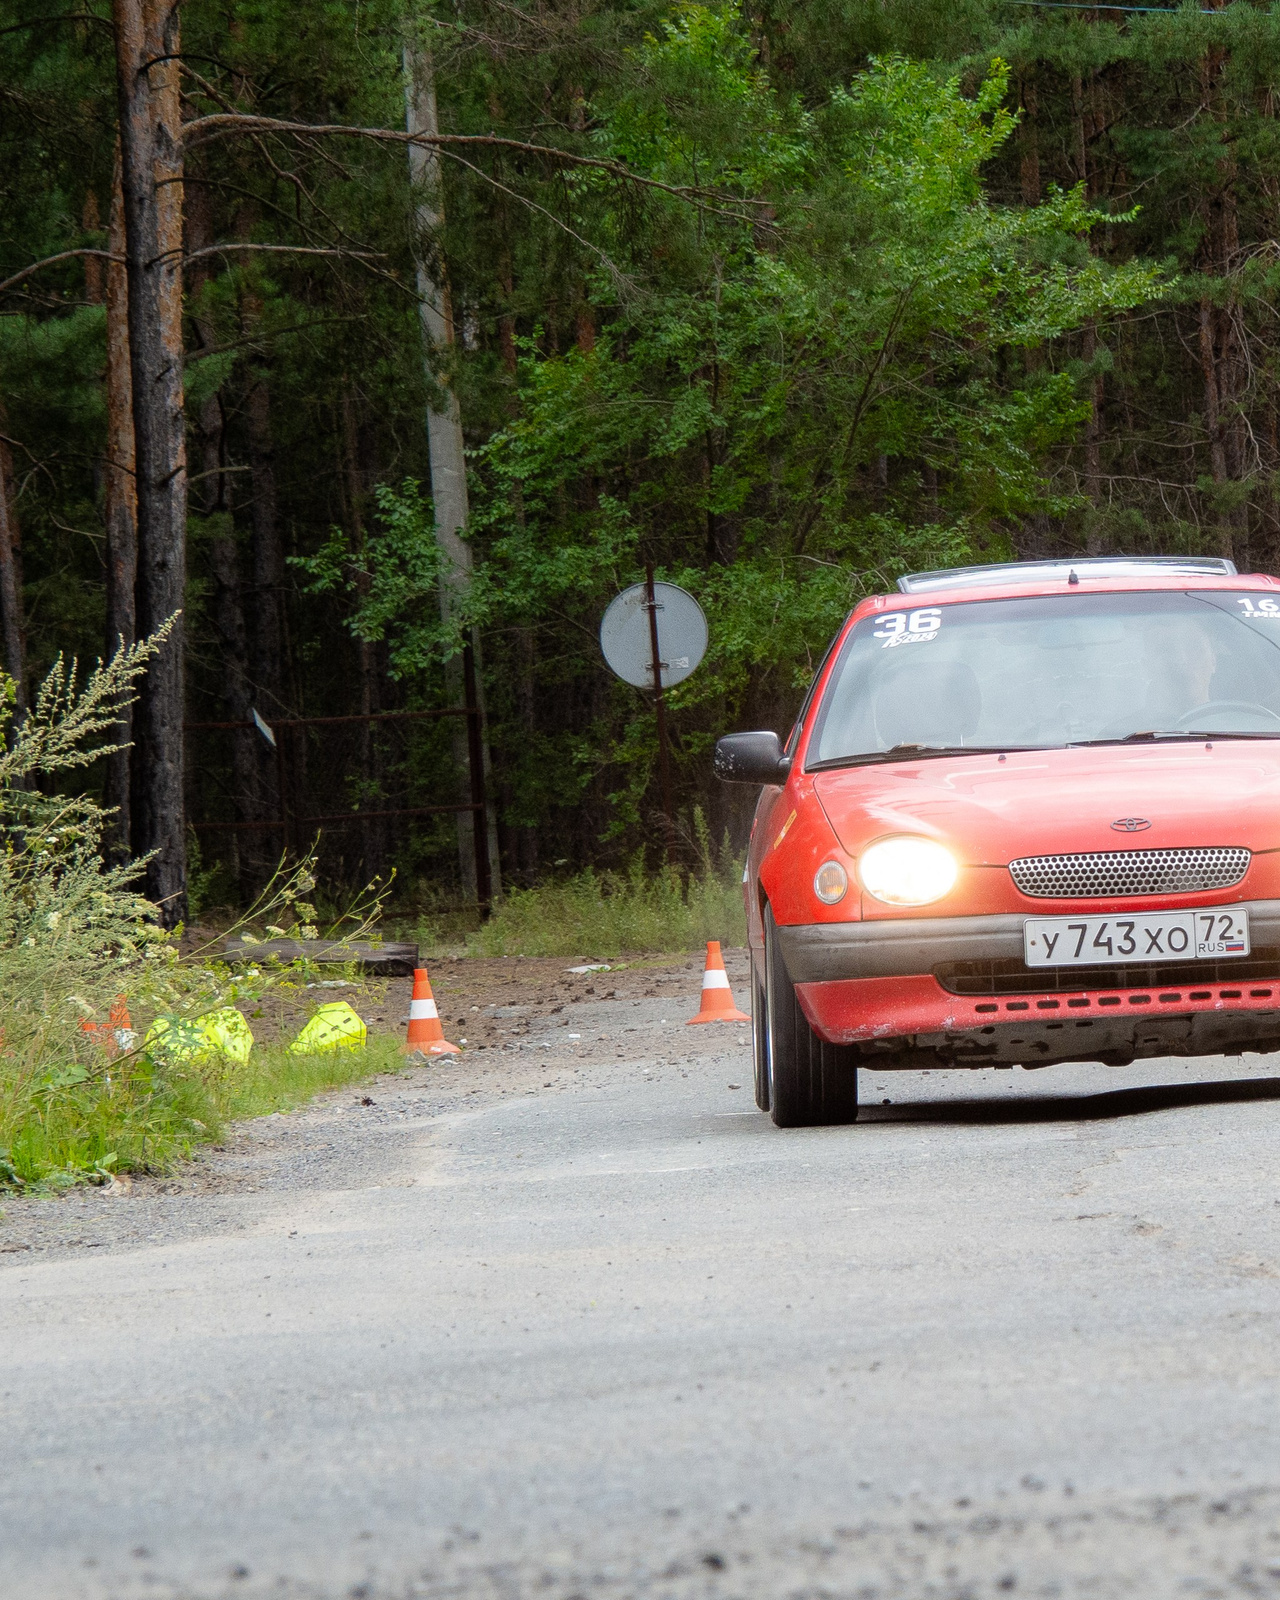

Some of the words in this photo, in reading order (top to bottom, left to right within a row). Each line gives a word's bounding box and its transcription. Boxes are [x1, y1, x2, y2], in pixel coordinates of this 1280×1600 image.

[1237, 598, 1279, 611] 16
[873, 608, 942, 637] 36
[1200, 914, 1235, 942] 72
[1198, 941, 1225, 953] RUS
